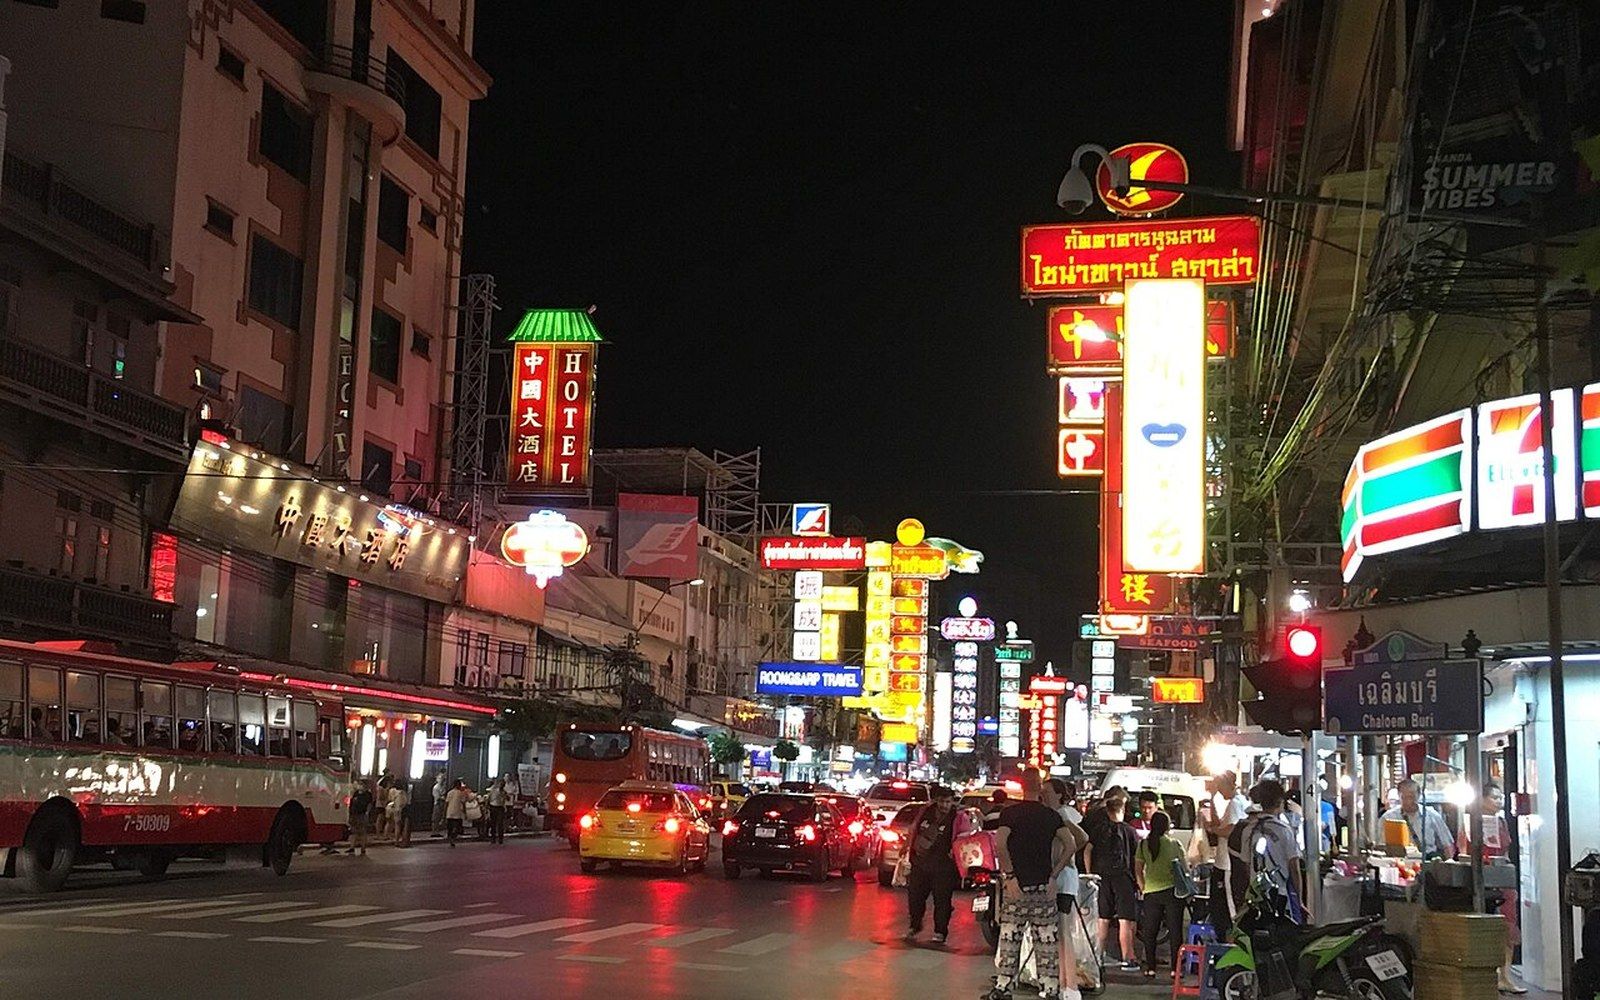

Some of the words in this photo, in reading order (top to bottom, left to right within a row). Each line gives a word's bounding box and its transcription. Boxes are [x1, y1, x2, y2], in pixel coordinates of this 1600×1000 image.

[1424, 161, 1556, 190] SUMMER
[1424, 187, 1495, 209] VIBES
[560, 353, 582, 484] HOTEL
[1139, 638, 1198, 648] SEAFOOD
[822, 672, 860, 688] TRAVEL
[1358, 667, 1438, 713] เฉลิมบุรี
[1362, 713, 1407, 729] Chaloem
[1411, 713, 1435, 728] Buri
[124, 814, 170, 832] 7-50309
